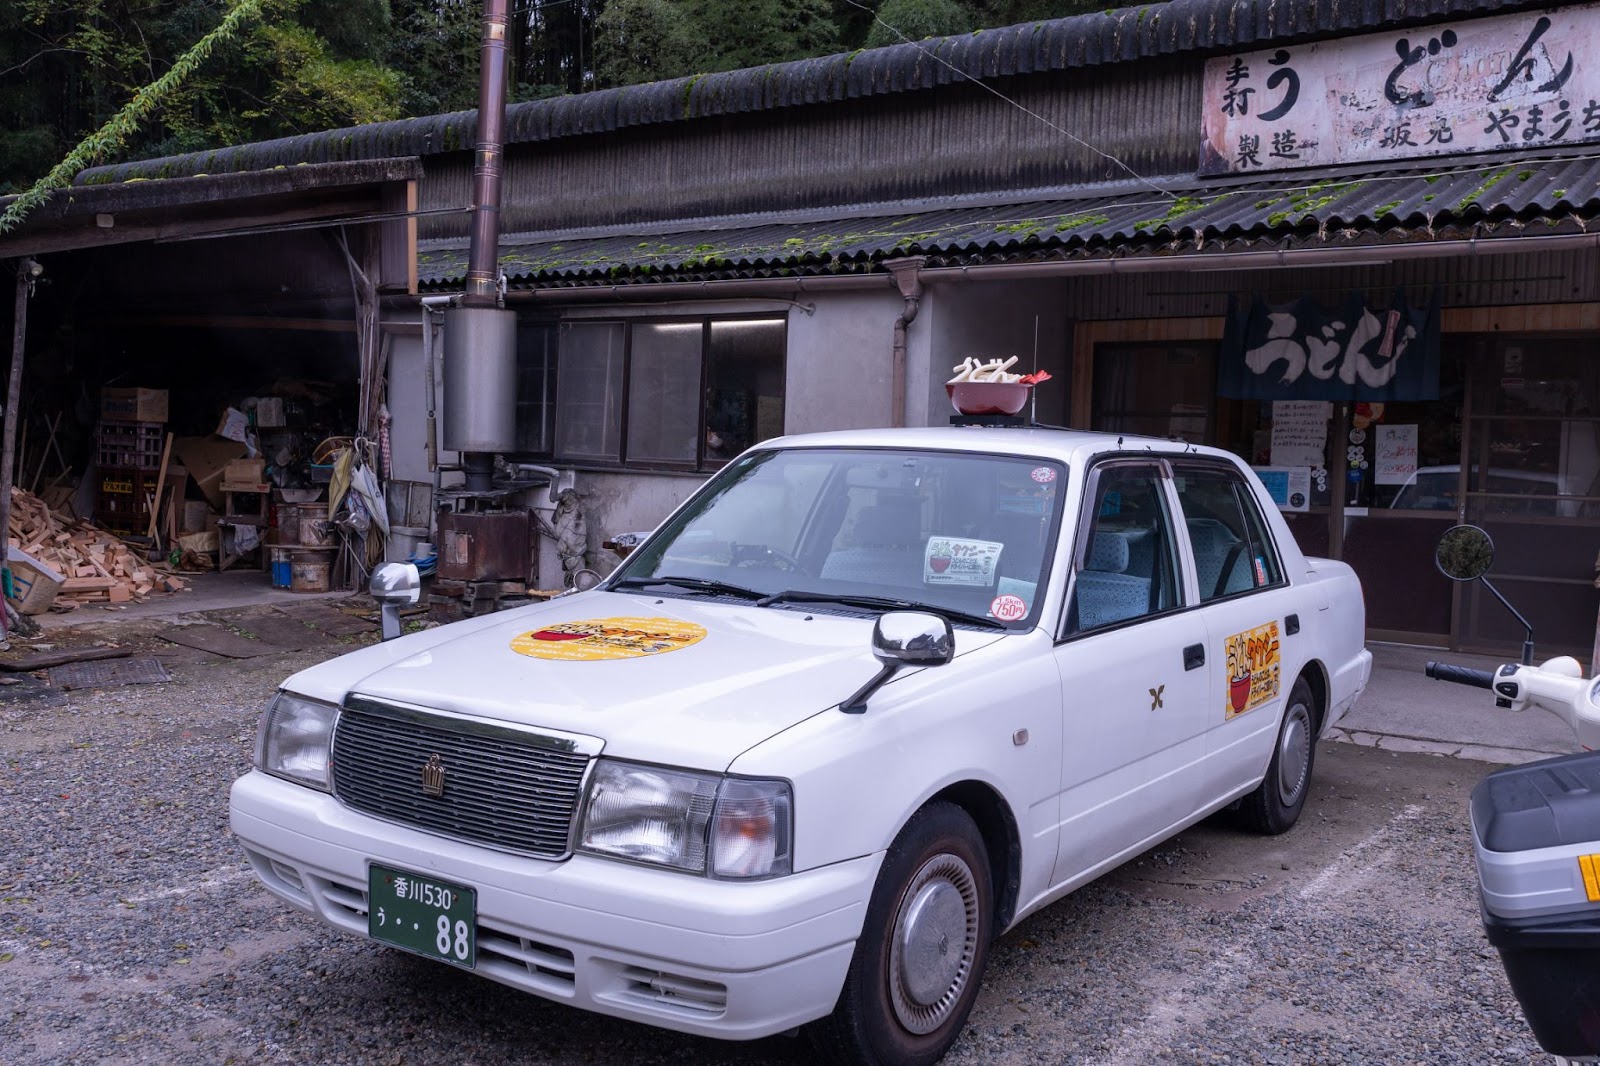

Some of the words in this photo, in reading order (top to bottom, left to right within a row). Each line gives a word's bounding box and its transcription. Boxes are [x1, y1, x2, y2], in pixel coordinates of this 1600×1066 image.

[1221, 57, 1256, 118] 手打
[1256, 16, 1573, 121] うどん
[1245, 306, 1417, 389] うどん
[377, 906, 386, 926] う
[436, 914, 469, 960] 88
